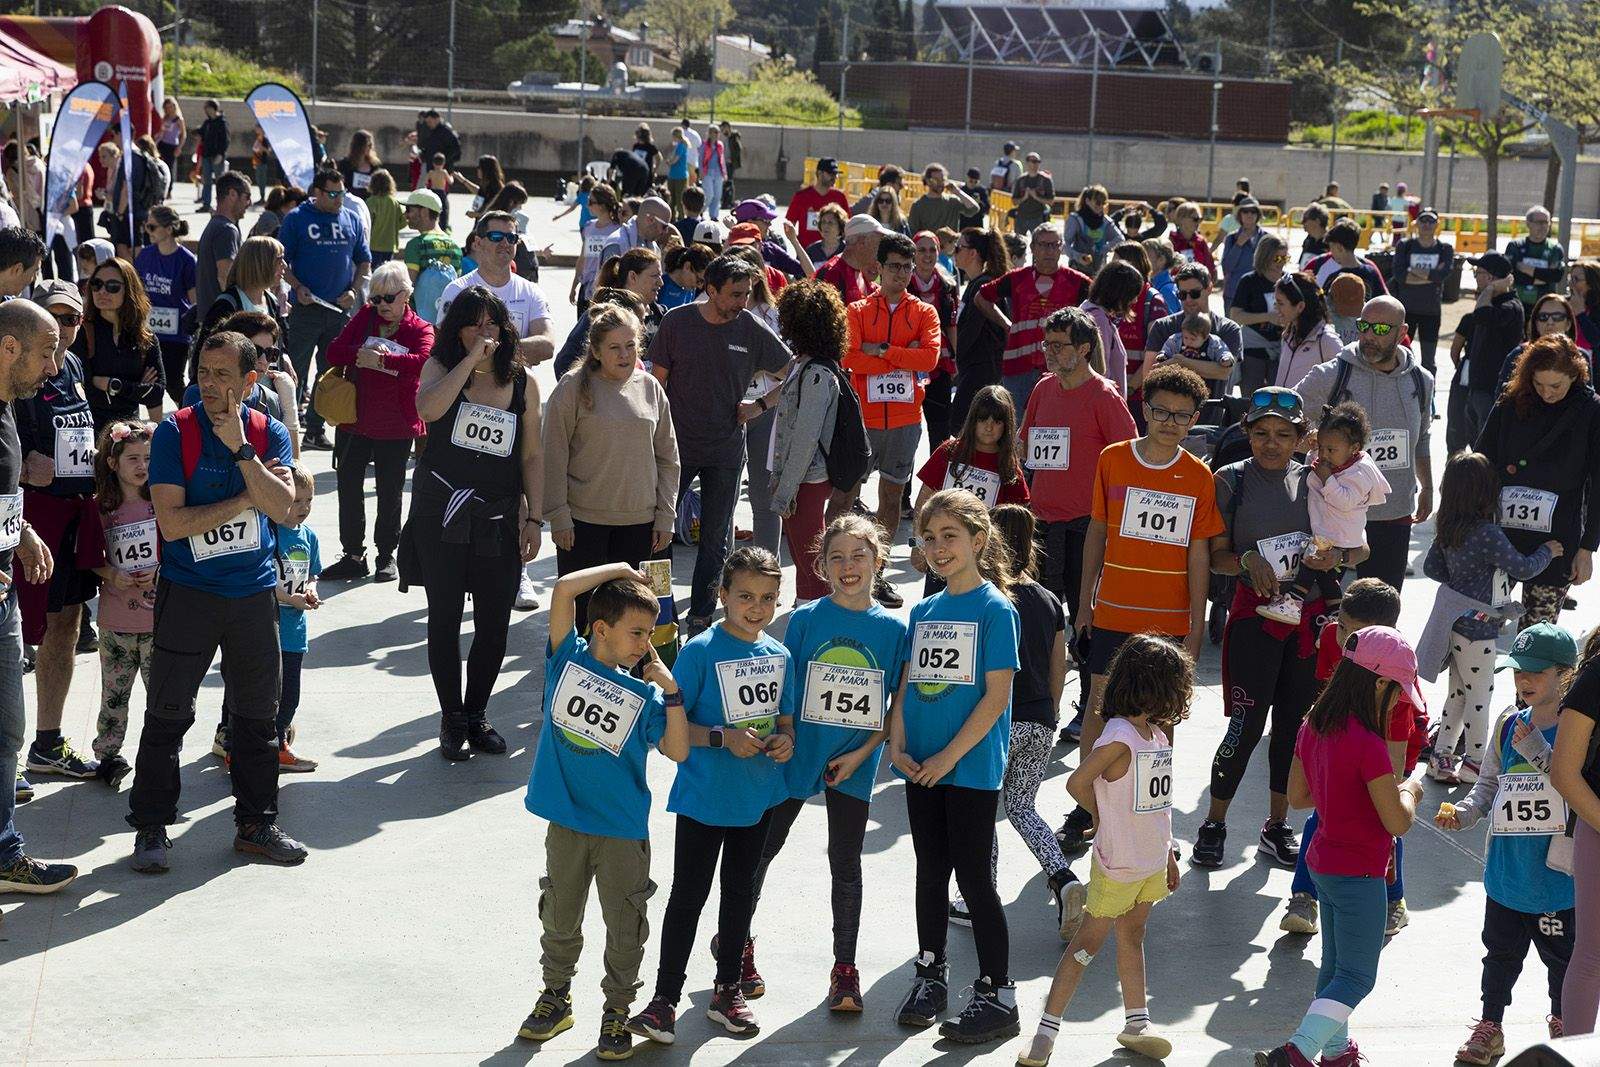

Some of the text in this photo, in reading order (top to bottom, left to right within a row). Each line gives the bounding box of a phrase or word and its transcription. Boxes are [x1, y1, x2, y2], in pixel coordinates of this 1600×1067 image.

[150, 317, 171, 329] 044
[877, 382, 905, 395] 196
[465, 423, 504, 445] 003
[1034, 445, 1061, 460] 017
[1140, 496, 1179, 510] EN MARXA
[1506, 503, 1541, 521] 131
[1137, 510, 1178, 533] 101
[203, 521, 248, 546] 067
[115, 542, 153, 565] 145
[1278, 553, 1304, 572] 10
[922, 630, 958, 640] EN MARXA
[918, 647, 960, 669] 052
[734, 663, 776, 678] EN MARXA
[822, 673, 869, 687] EN MARXA
[577, 679, 626, 707] EN MARXA
[738, 681, 778, 706] 066
[820, 690, 871, 716] 154
[567, 695, 621, 734] 065
[1151, 759, 1161, 769] EN
[1503, 782, 1545, 792] EN MARXA
[1502, 799, 1552, 822] 155
[1538, 916, 1564, 937] 62
